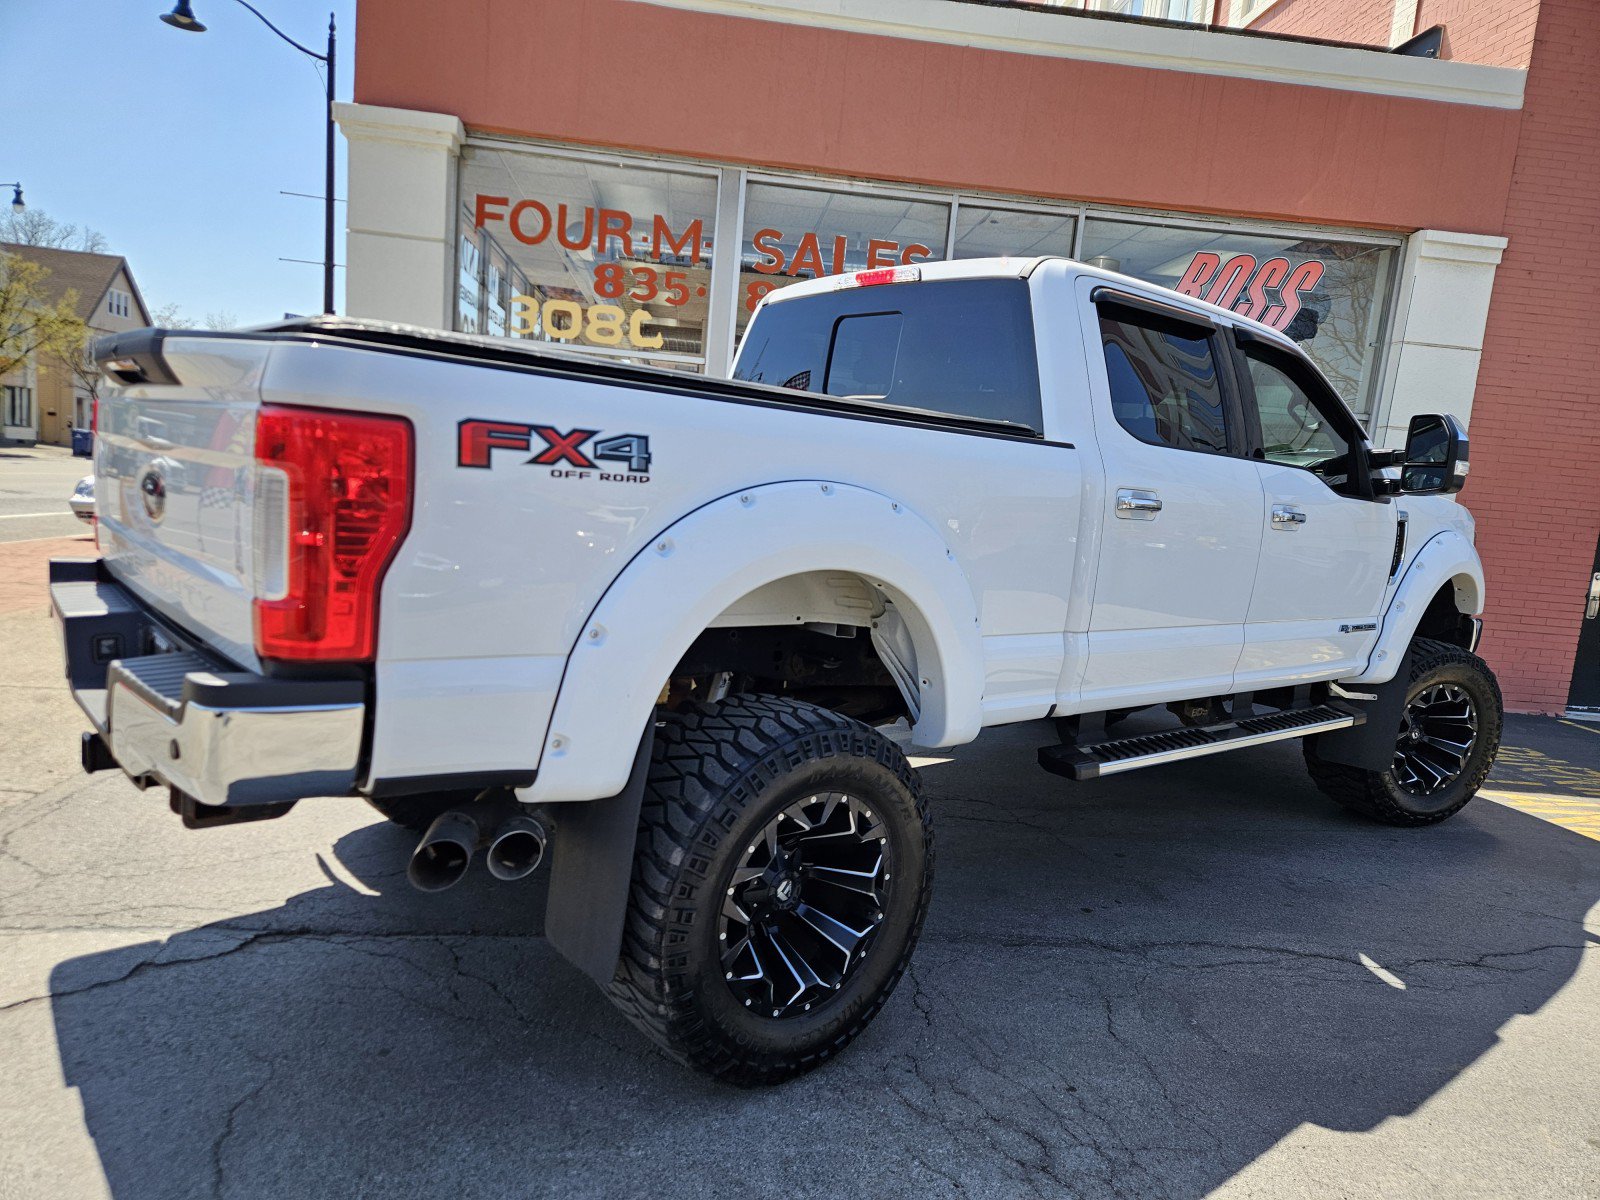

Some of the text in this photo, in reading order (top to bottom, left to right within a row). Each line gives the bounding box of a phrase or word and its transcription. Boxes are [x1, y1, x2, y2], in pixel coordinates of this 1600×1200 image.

[1174, 250, 1326, 333] BOSS
[456, 417, 652, 473] FX4
[550, 469, 651, 484] OFF ROAD
